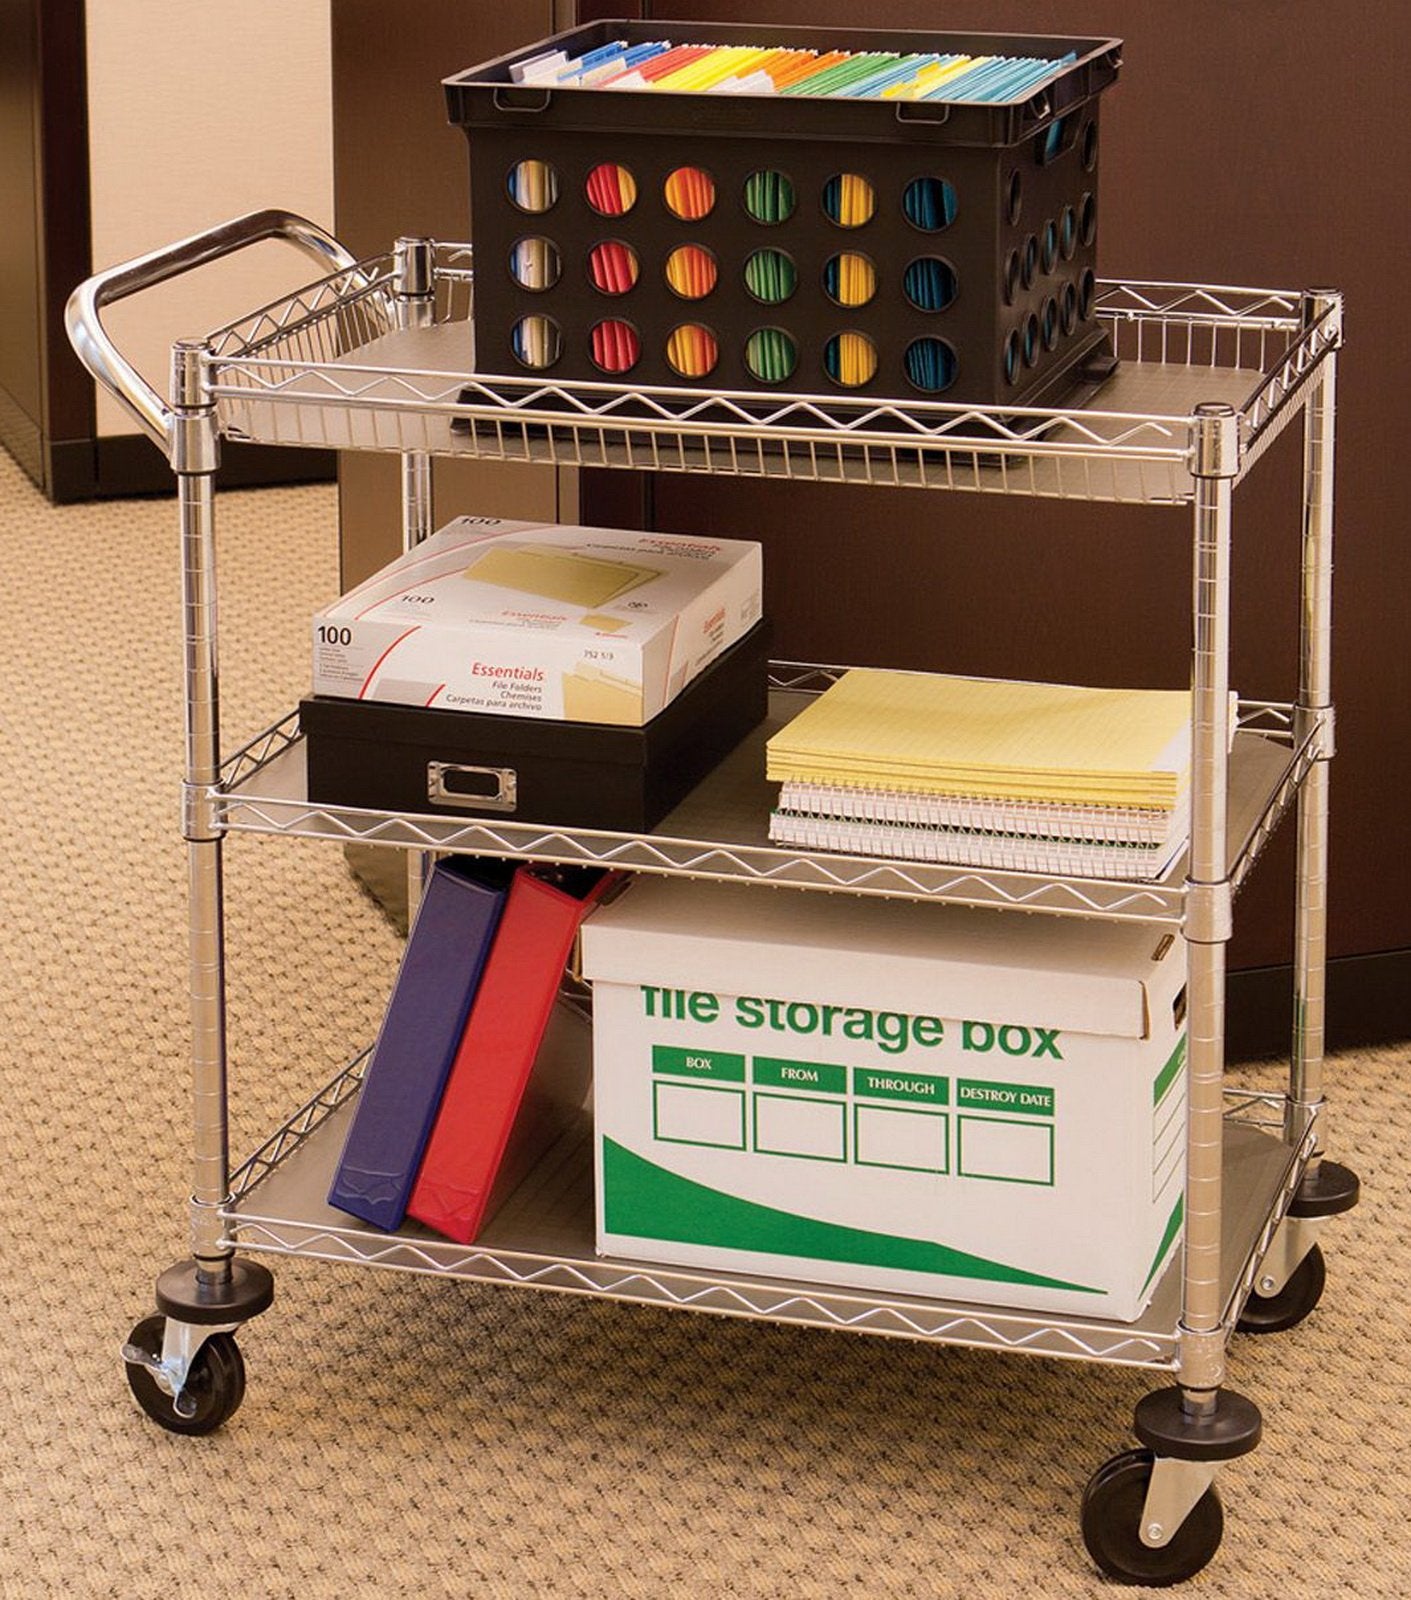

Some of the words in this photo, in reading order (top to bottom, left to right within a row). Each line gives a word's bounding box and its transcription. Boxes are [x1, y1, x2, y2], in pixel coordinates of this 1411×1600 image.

[317, 625, 353, 647] 100
[471, 661, 545, 683] Essentials
[491, 680, 510, 691] File
[511, 682, 543, 694] Folders
[499, 690, 543, 703] Chemises
[445, 692, 486, 707] Carpetas
[486, 699, 508, 709] para
[508, 700, 543, 712] archivo
[735, 995, 945, 1054] storage
[962, 1018, 1065, 1060] box
[686, 1056, 713, 1071] BOX
[780, 1066, 820, 1083] FROM
[867, 1075, 937, 1096] THROUGH
[960, 1086, 1019, 1105] DESTROY
[1020, 1093, 1053, 1109] DATE
